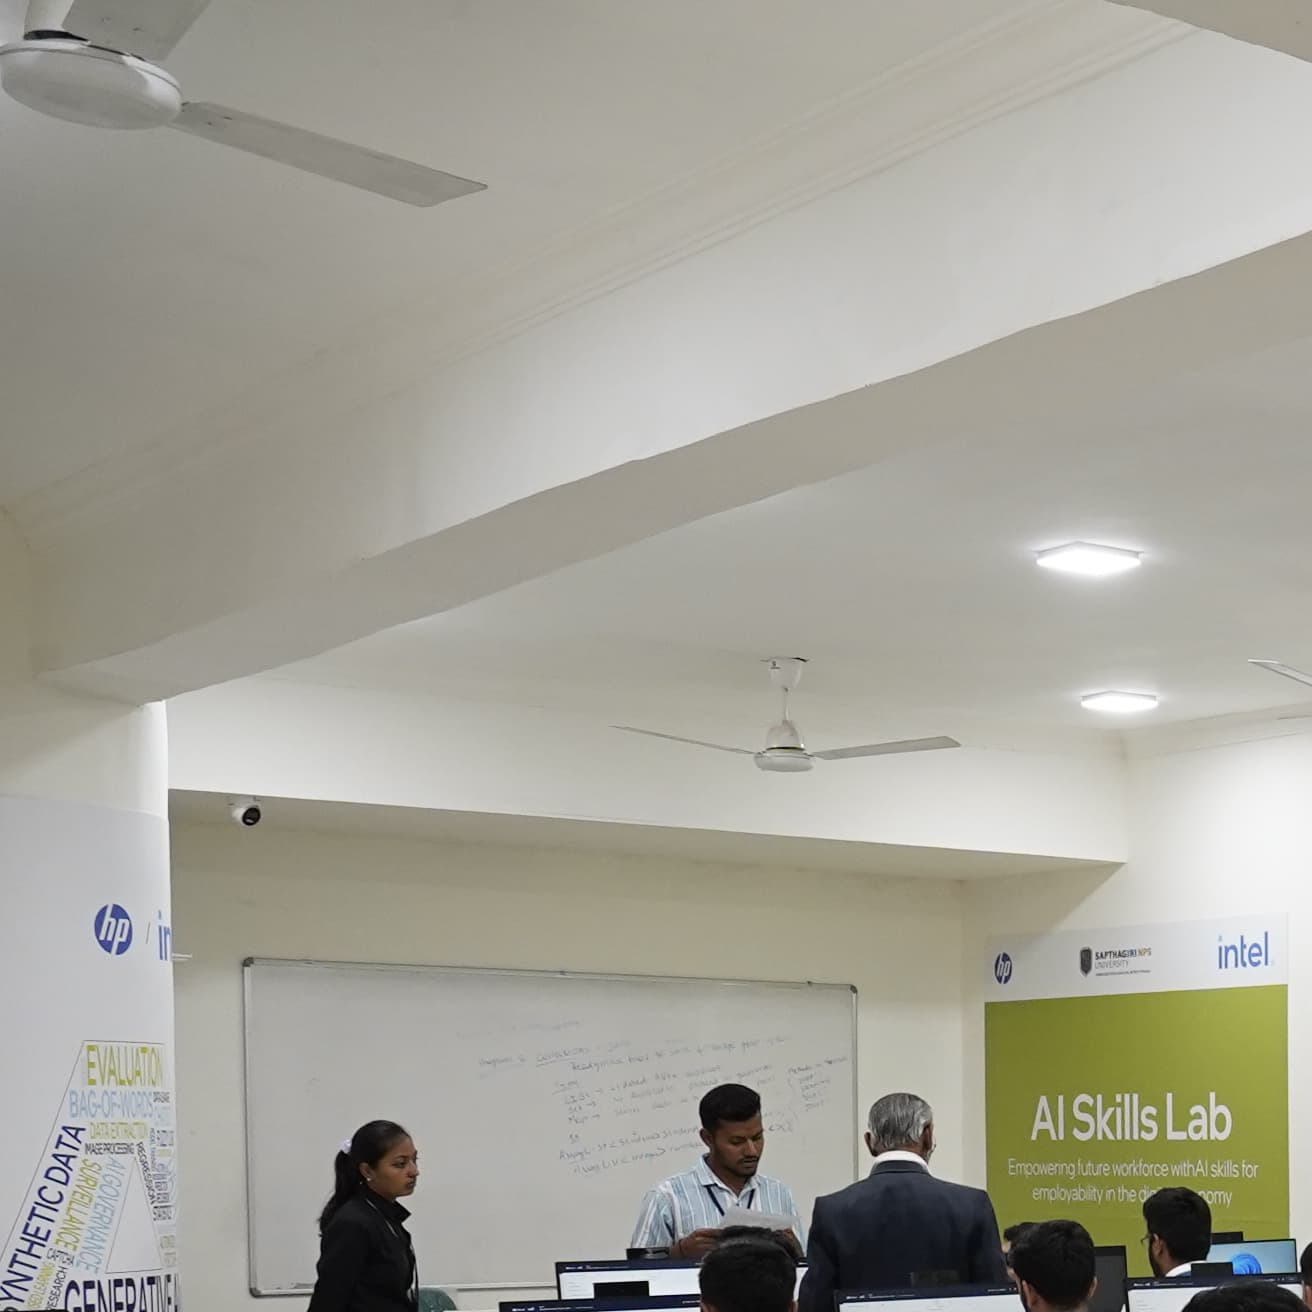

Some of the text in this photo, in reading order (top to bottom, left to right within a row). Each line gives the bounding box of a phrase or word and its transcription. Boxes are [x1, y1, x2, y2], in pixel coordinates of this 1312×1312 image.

[94, 904, 133, 955] hp
[995, 952, 1012, 984] hp
[1218, 931, 1269, 970] intel
[1031, 1092, 1232, 1141] AI Skills Lab
[1008, 1159, 1075, 1179] Empowering
[1077, 1159, 1110, 1177] future
[1113, 1159, 1169, 1177] workforce
[1211, 1160, 1239, 1178] skills
[1241, 1161, 1258, 1178] for
[1032, 1186, 1103, 1205] employability
[1106, 1188, 1116, 1201] in
[1118, 1186, 1138, 1201] the
[0, 1185, 64, 1311] YNTHETIC
[44, 1125, 86, 1186] DATA
